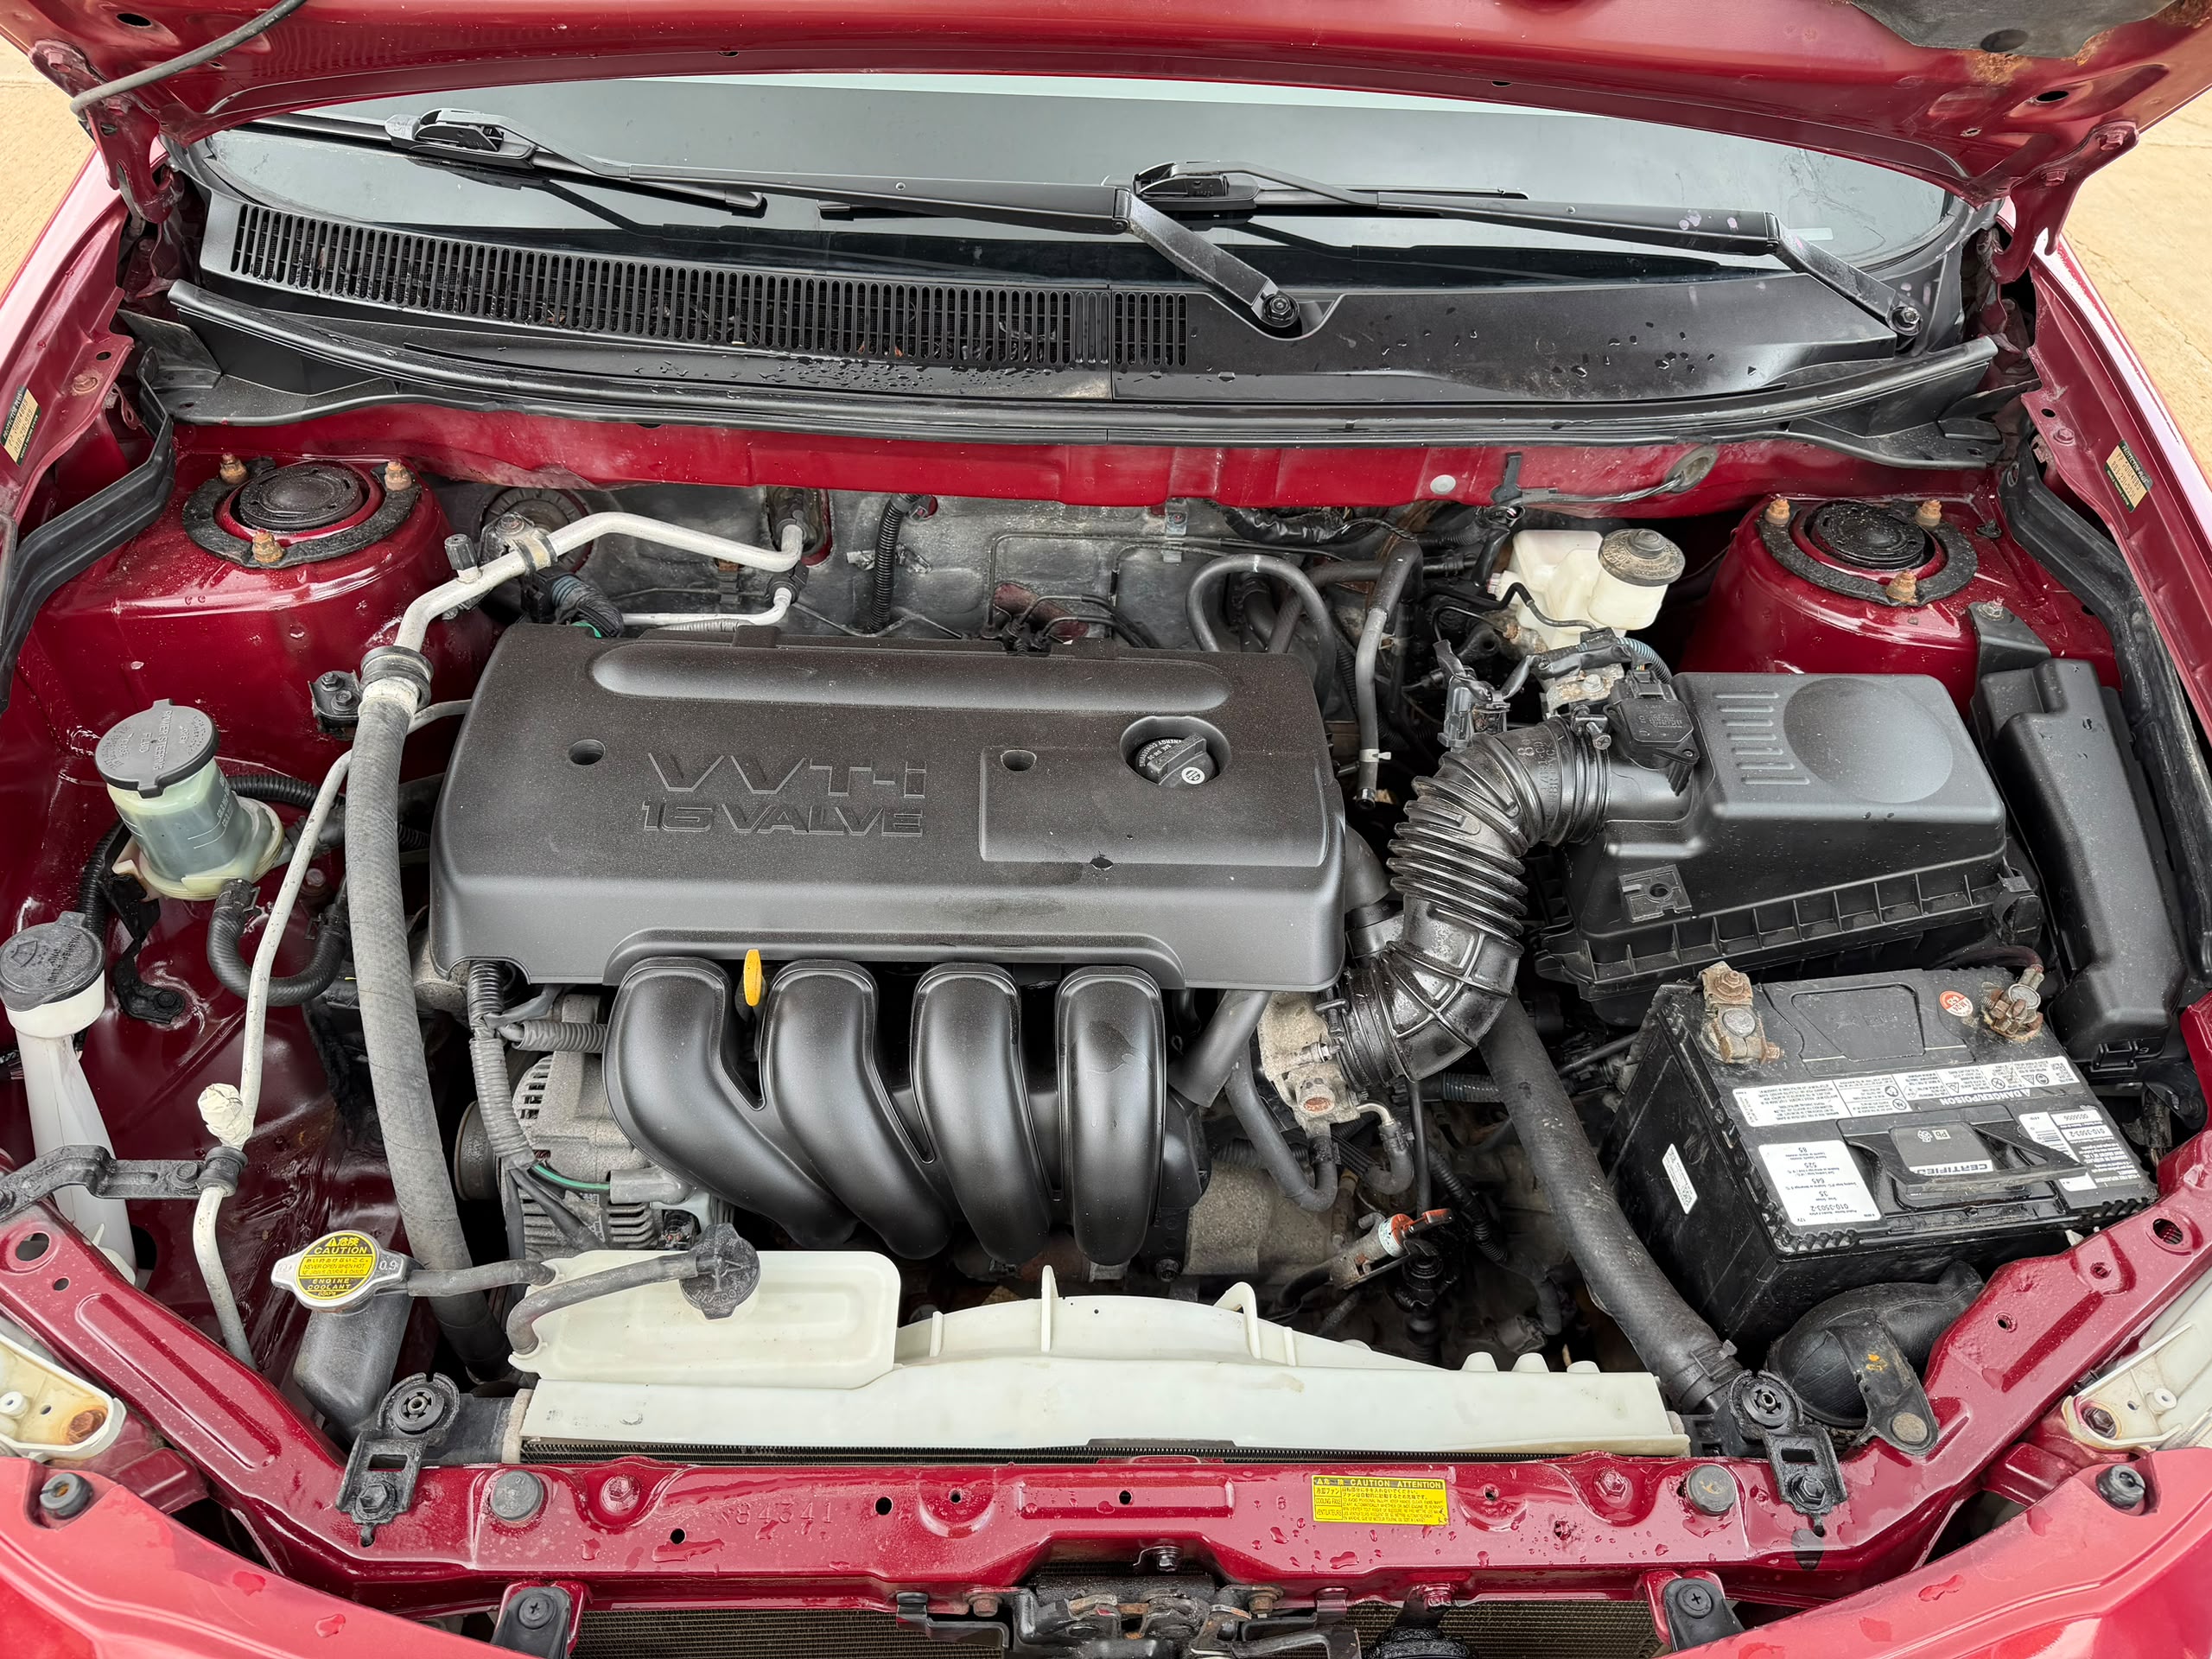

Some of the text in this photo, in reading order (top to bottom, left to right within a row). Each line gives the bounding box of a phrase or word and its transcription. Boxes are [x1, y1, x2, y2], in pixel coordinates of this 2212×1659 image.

[3, 392, 22, 438] PROTECTOR PLUS
[2121, 445, 2139, 472] PROTECTOR
[138, 732, 153, 753] FLUID
[153, 709, 173, 770] POWER STEERING
[48, 934, 82, 984] WASHER FLUID
[1938, 1090, 2021, 1106] DANGER/POISON
[1936, 1129, 1948, 1139] Pb
[1916, 1163, 1988, 1174] CERTIFIED
[1810, 1203, 1848, 1211] 010-3503-2
[338, 1237, 359, 1246] 危険
[378, 1260, 399, 1271] 0.9
